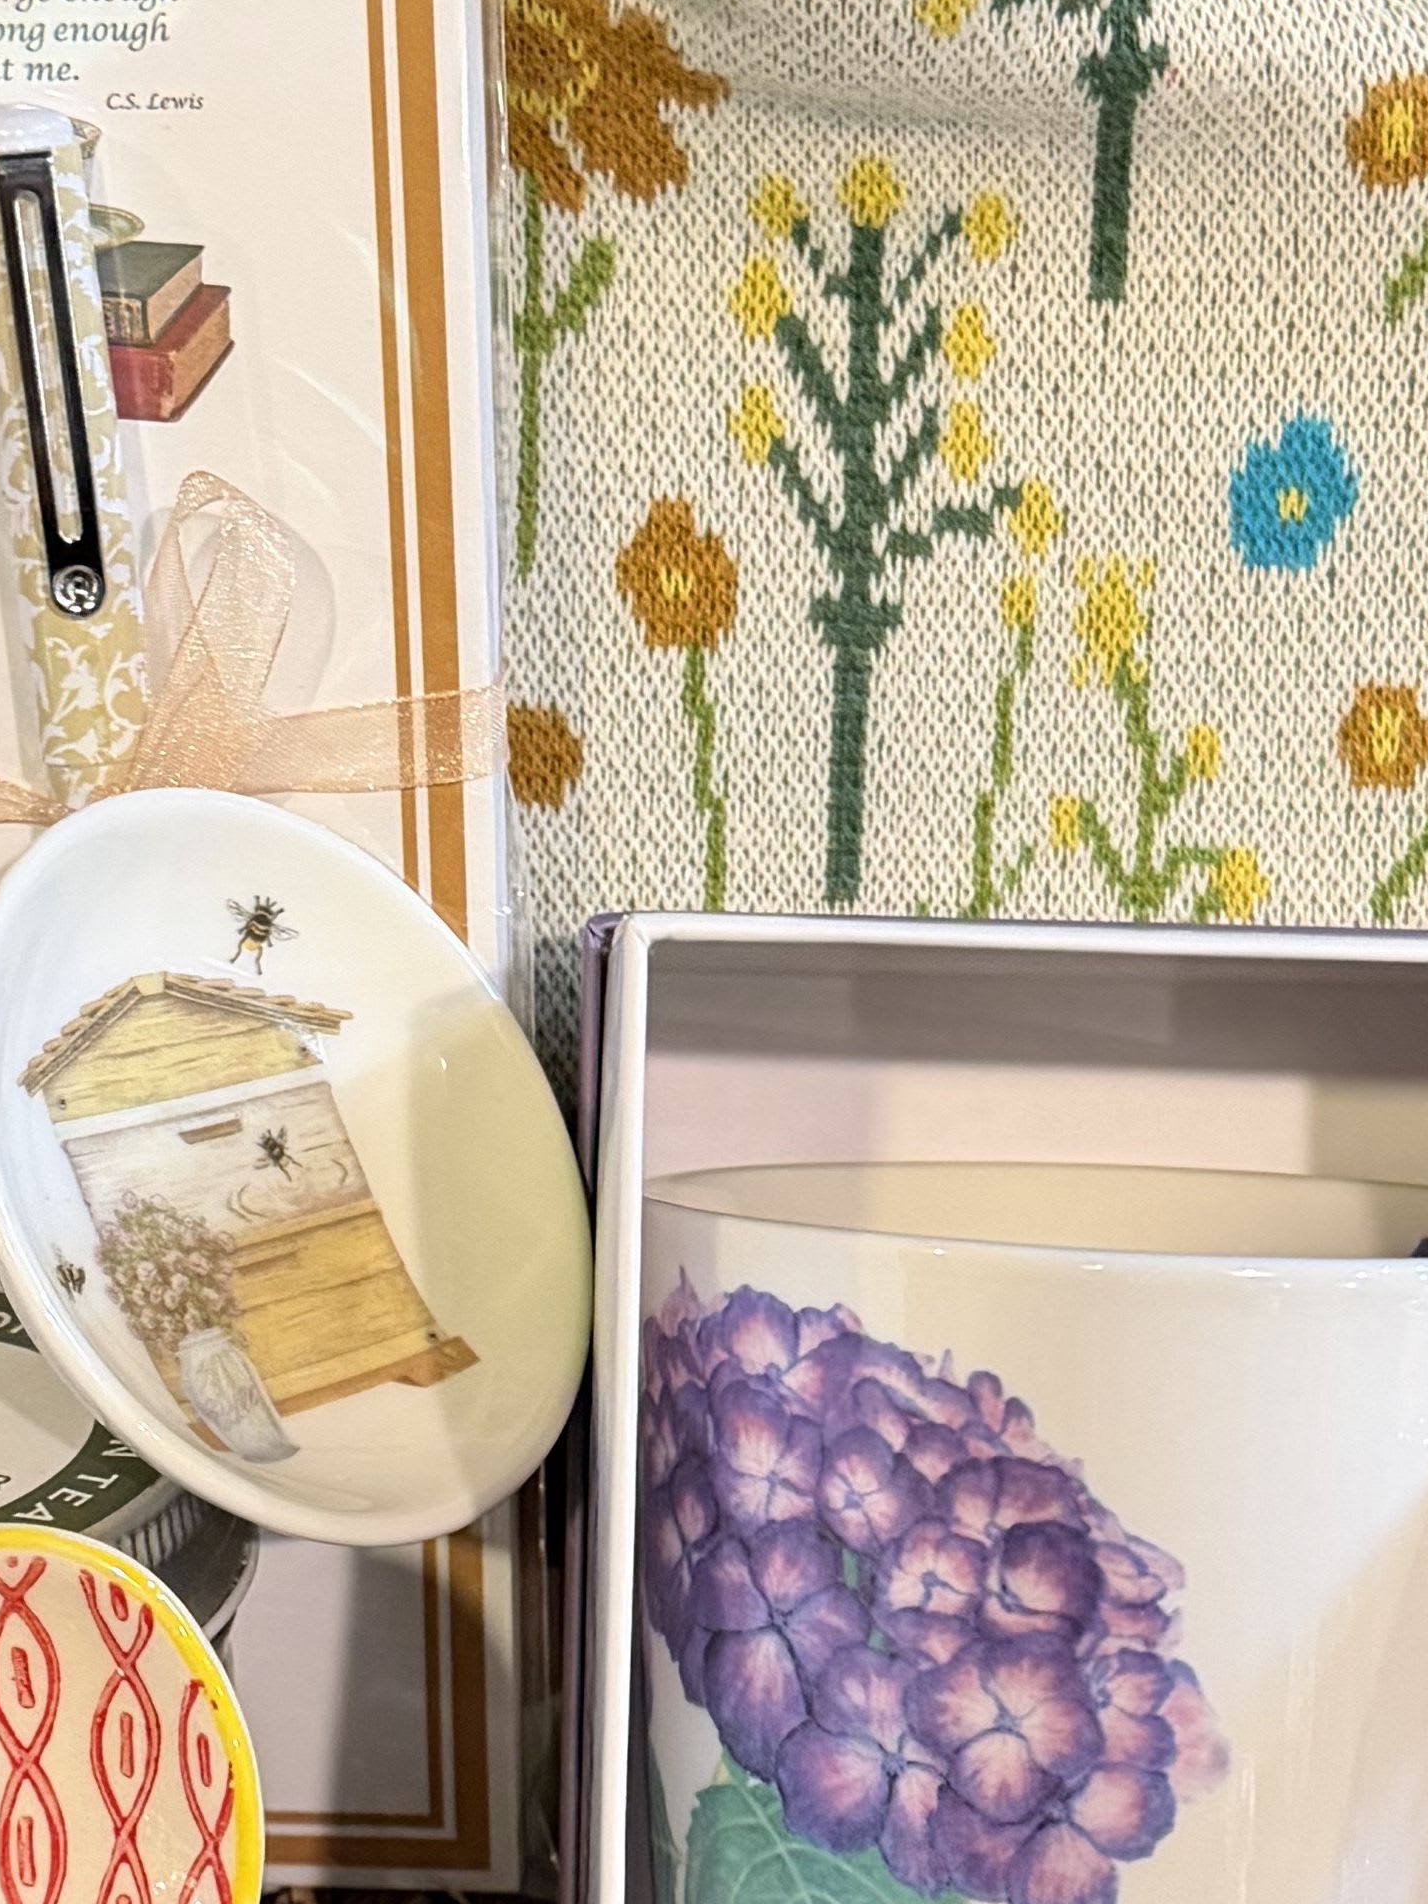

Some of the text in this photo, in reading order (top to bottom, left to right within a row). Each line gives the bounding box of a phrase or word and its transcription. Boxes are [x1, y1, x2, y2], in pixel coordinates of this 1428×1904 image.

[54, 12, 171, 53] enough
[24, 62, 81, 83] me.
[106, 92, 205, 111] C.S. Lewis
[12, 1474, 119, 1522] TEA
